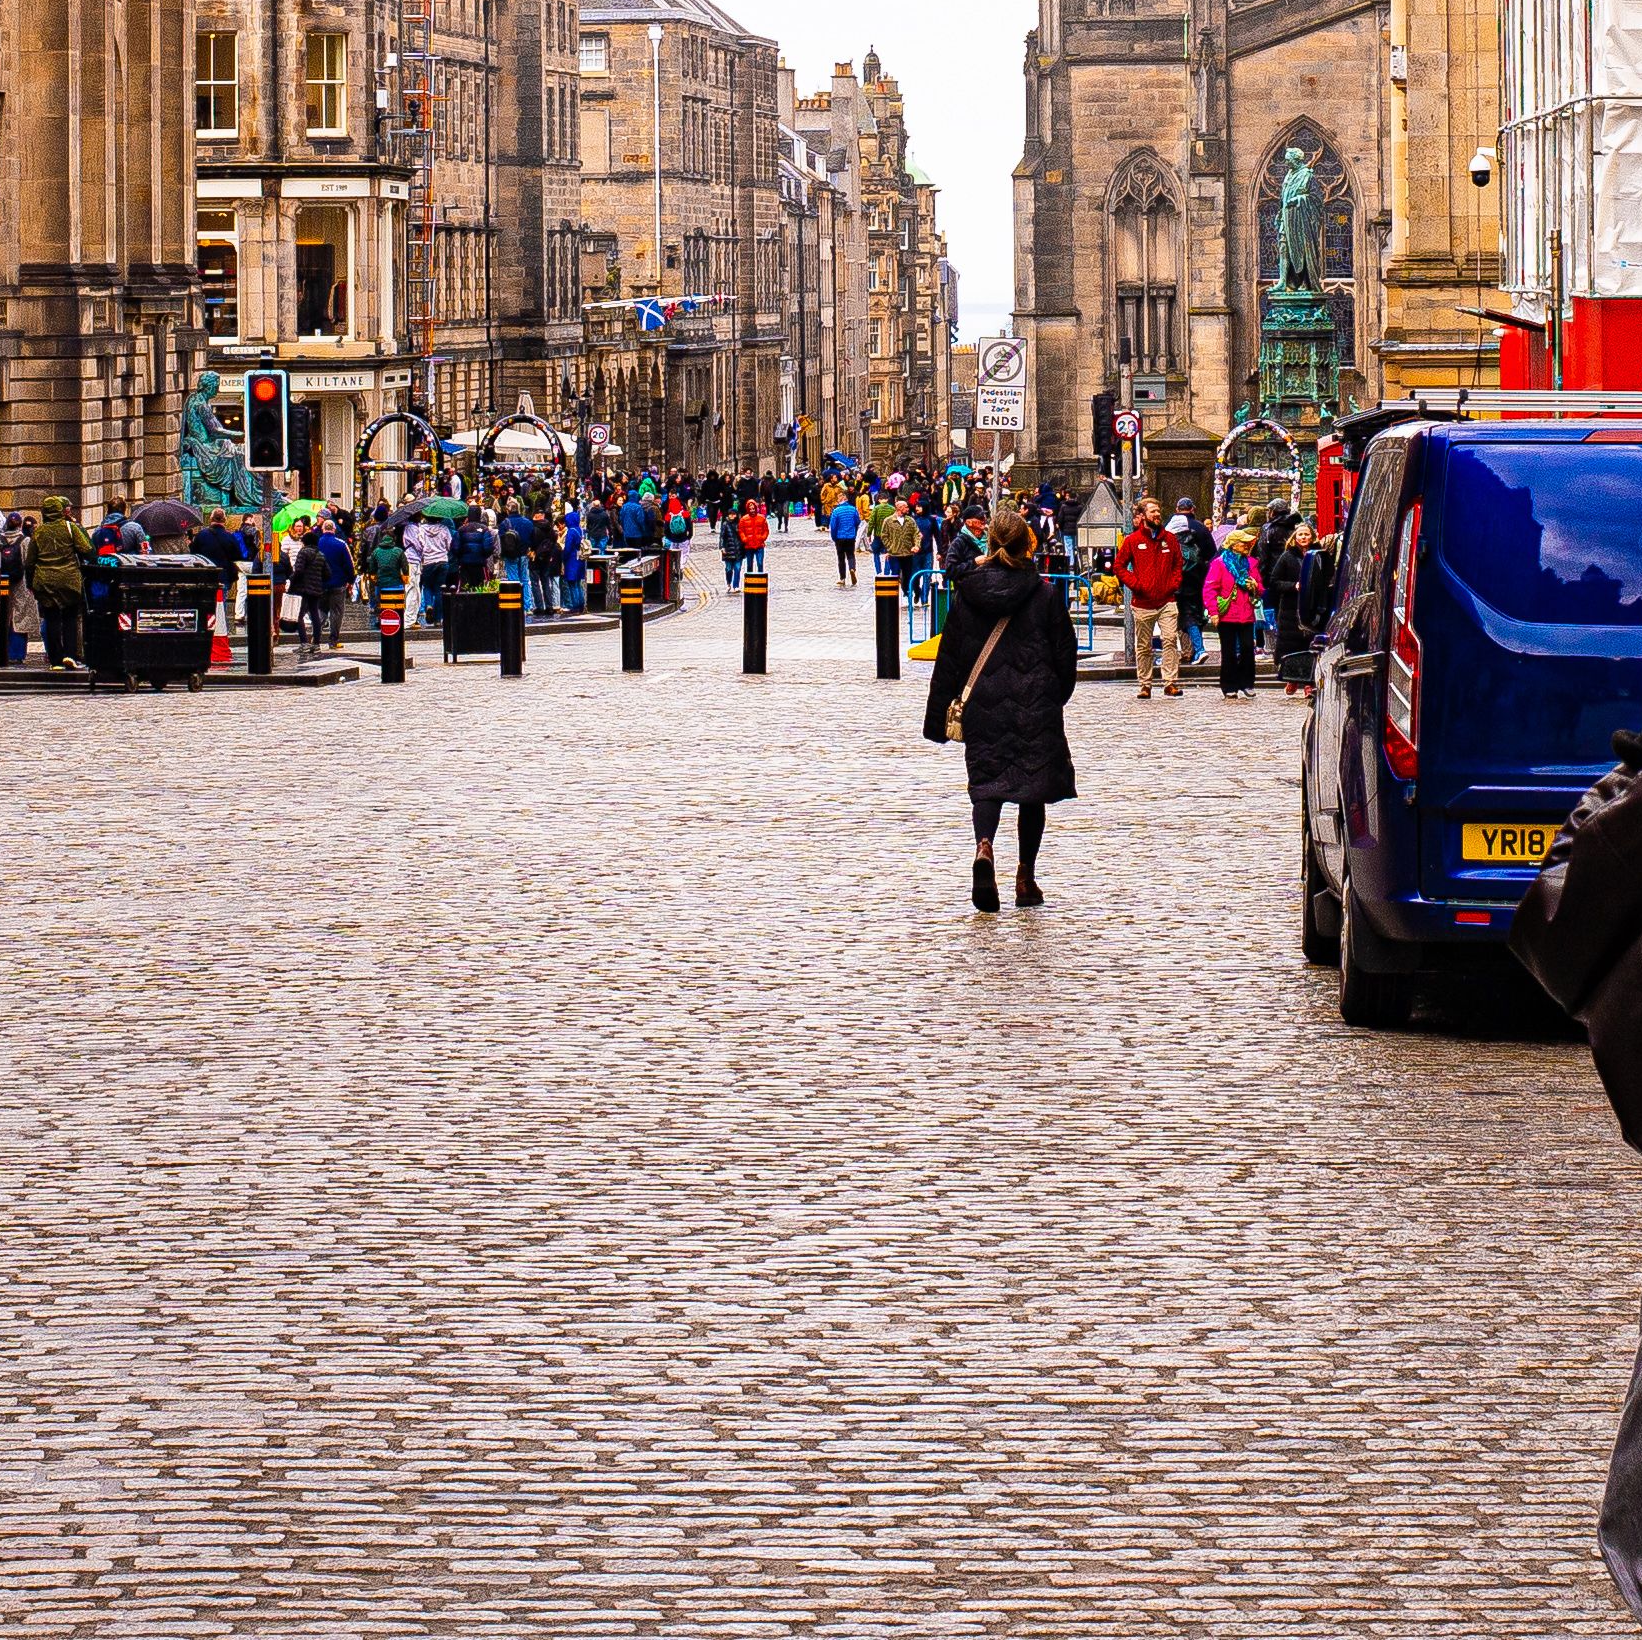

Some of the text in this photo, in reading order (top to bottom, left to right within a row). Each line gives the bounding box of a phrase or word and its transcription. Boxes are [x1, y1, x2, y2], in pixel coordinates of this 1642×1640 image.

[305, 376, 363, 387] KILTANE
[981, 388, 1022, 396] Pedestrian
[982, 416, 1018, 426] ENDS
[592, 431, 605, 439] 20
[1482, 829, 1545, 856] YR18
